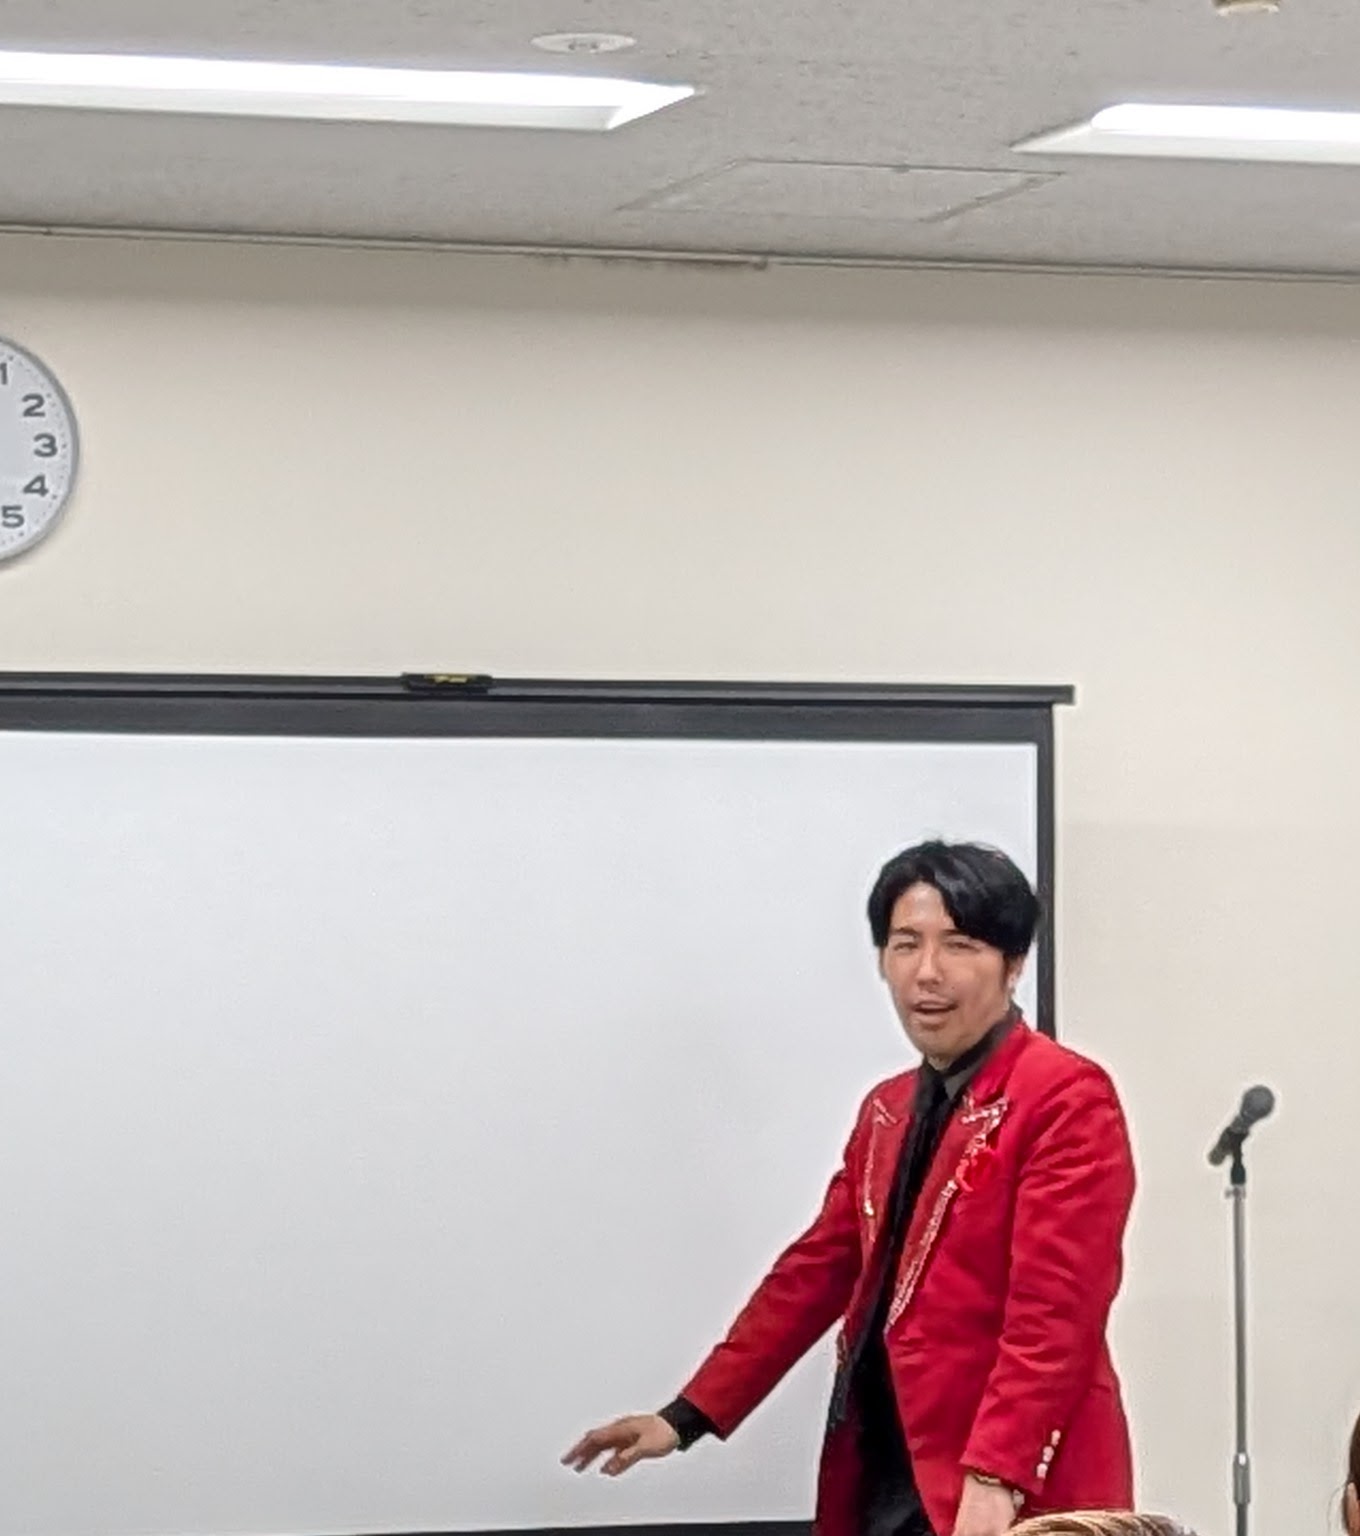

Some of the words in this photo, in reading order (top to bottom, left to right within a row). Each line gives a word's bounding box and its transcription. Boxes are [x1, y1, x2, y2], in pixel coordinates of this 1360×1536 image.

[21, 393, 46, 418] 2
[33, 432, 59, 458] 3
[22, 474, 49, 497] 4
[1, 505, 25, 529] 5
